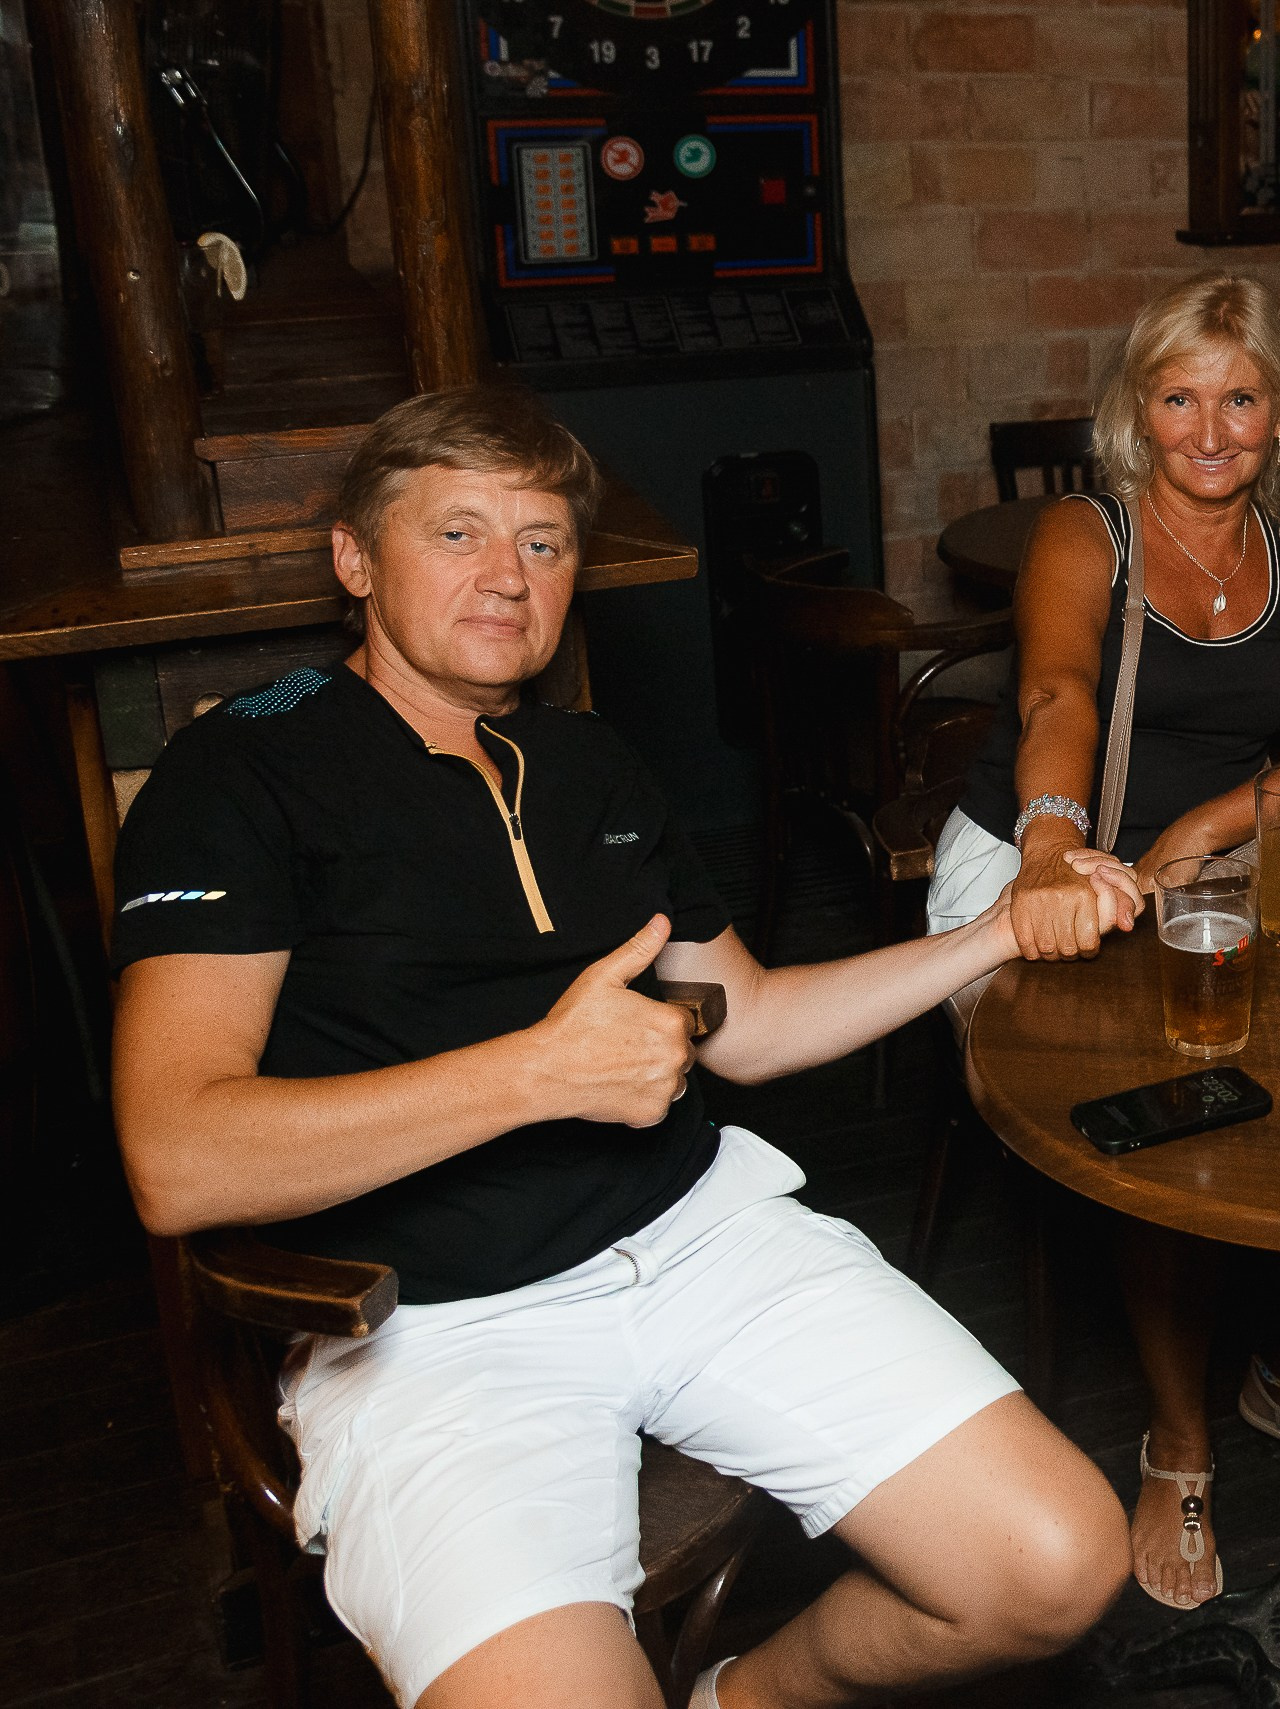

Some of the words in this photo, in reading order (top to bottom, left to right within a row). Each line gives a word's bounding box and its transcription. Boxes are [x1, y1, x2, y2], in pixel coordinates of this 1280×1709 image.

[549, 15, 564, 39] 7
[736, 15, 751, 39] 2
[590, 39, 617, 64] 19
[645, 46, 660, 70] 3
[687, 39, 714, 64] 17
